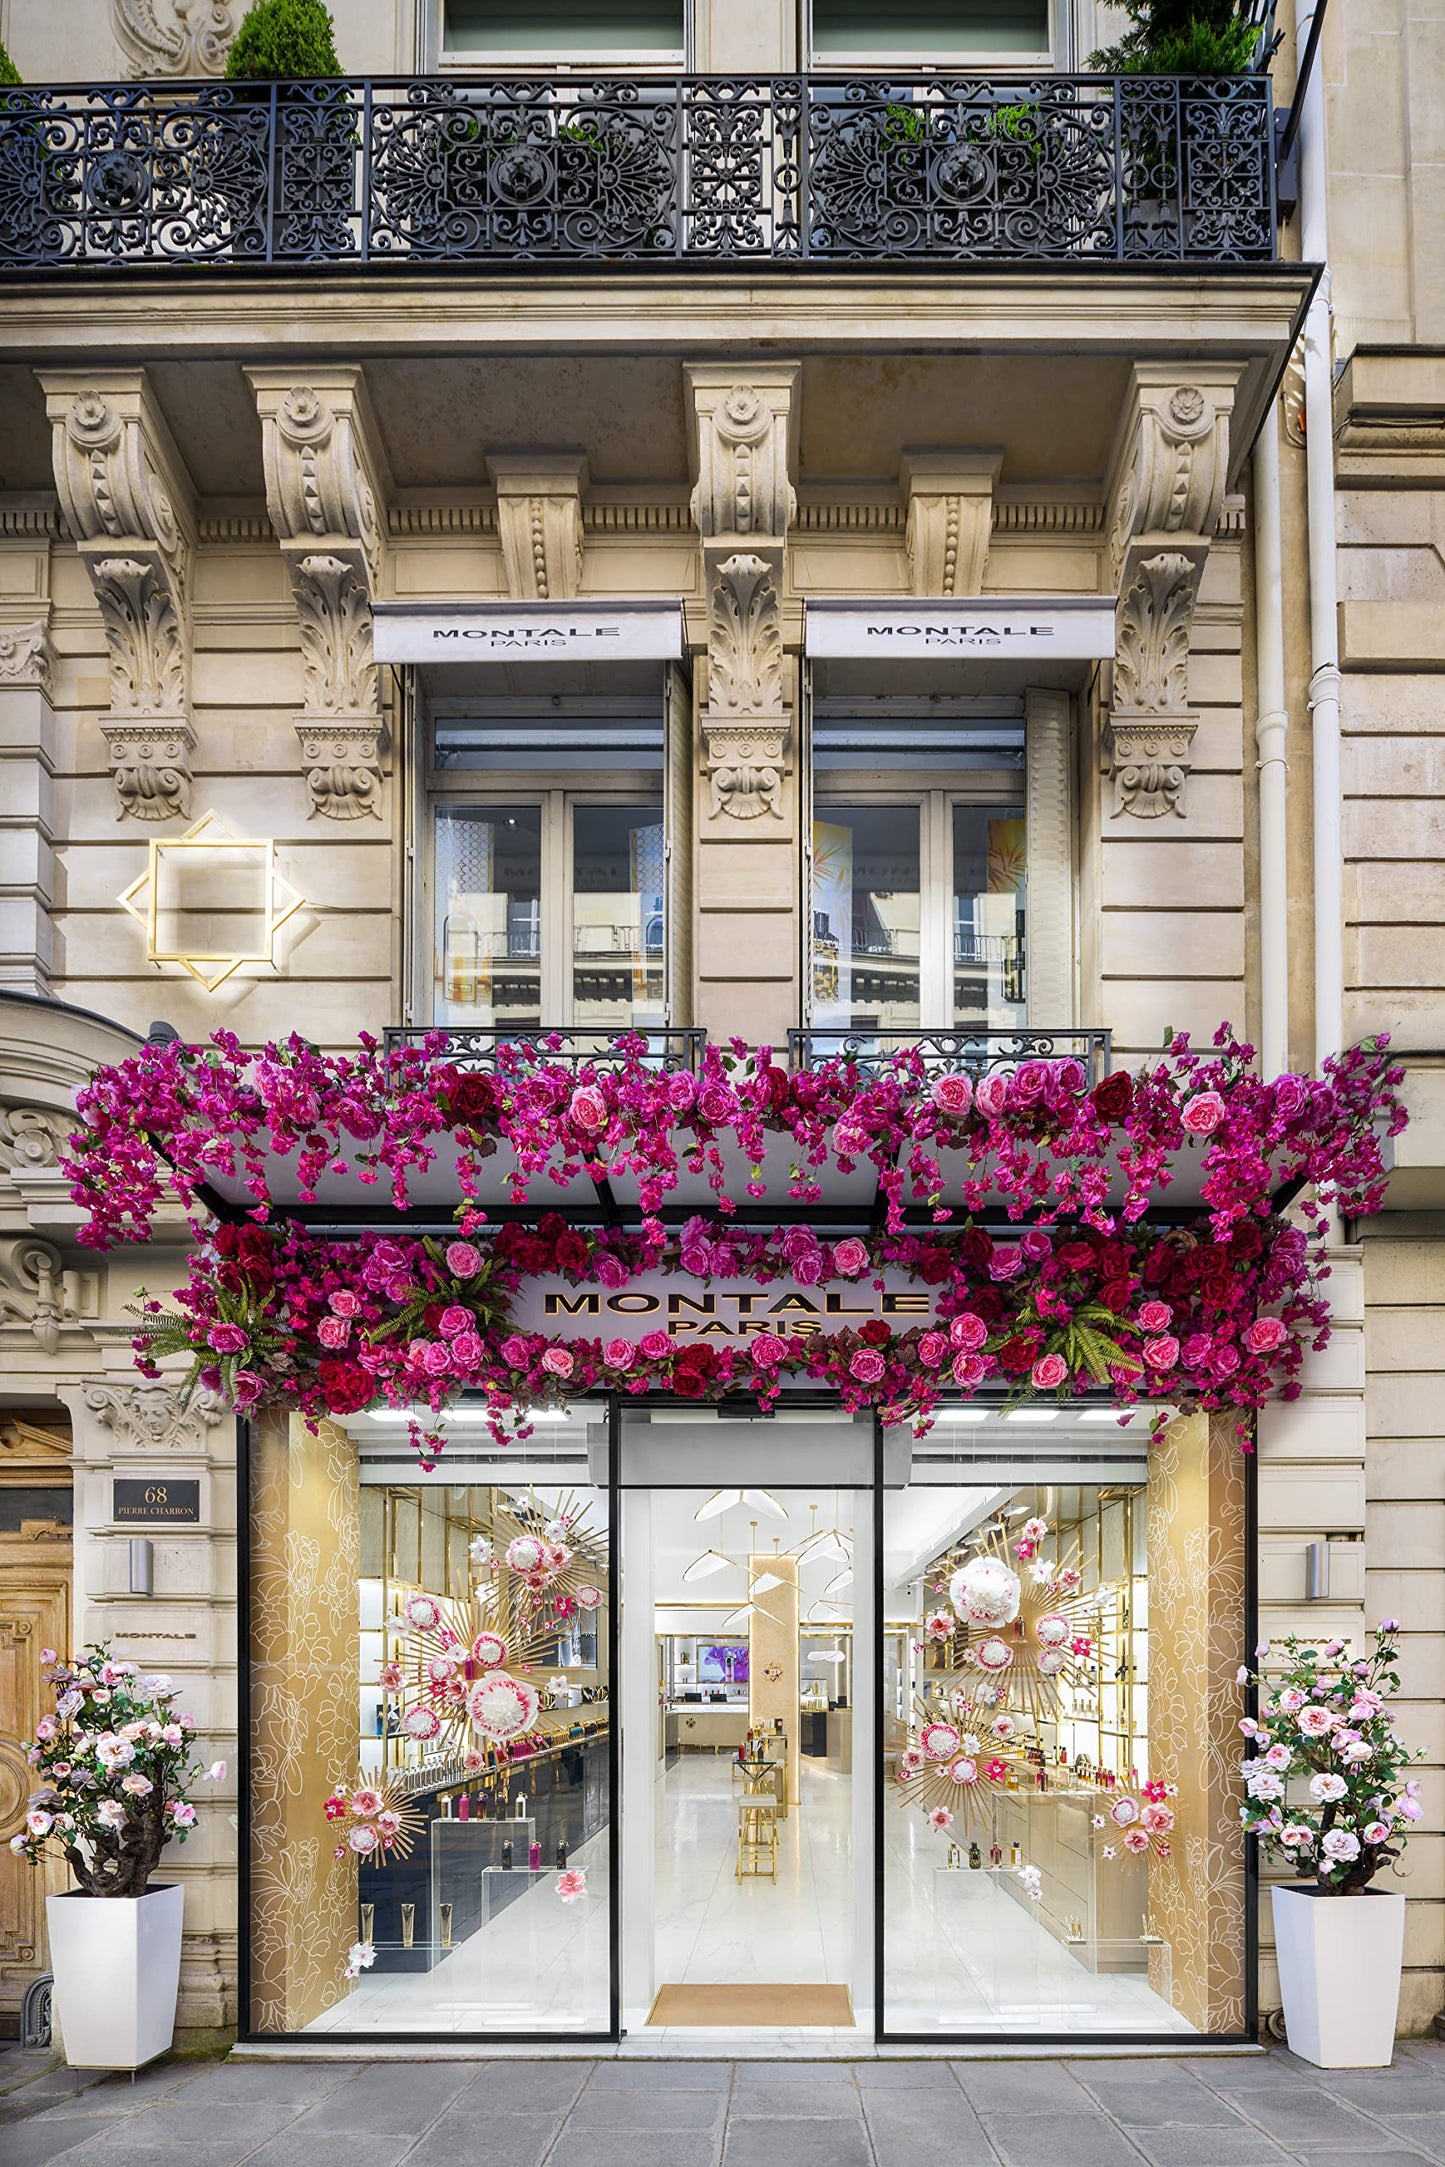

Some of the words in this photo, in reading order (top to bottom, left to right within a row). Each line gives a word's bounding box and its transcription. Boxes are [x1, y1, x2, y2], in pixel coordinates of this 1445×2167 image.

[433, 627, 620, 639] MONTALE
[867, 626, 1054, 636] MONTALE
[491, 639, 567, 647] PARIS
[926, 637, 1001, 645] PARIS
[544, 1293, 930, 1315] MONTALE
[668, 1320, 823, 1337] PARIS
[144, 1486, 168, 1503] 68
[118, 1506, 149, 1515] PIERRE
[150, 1507, 194, 1515] CHARRON
[115, 1631, 197, 1640] MONTALE
